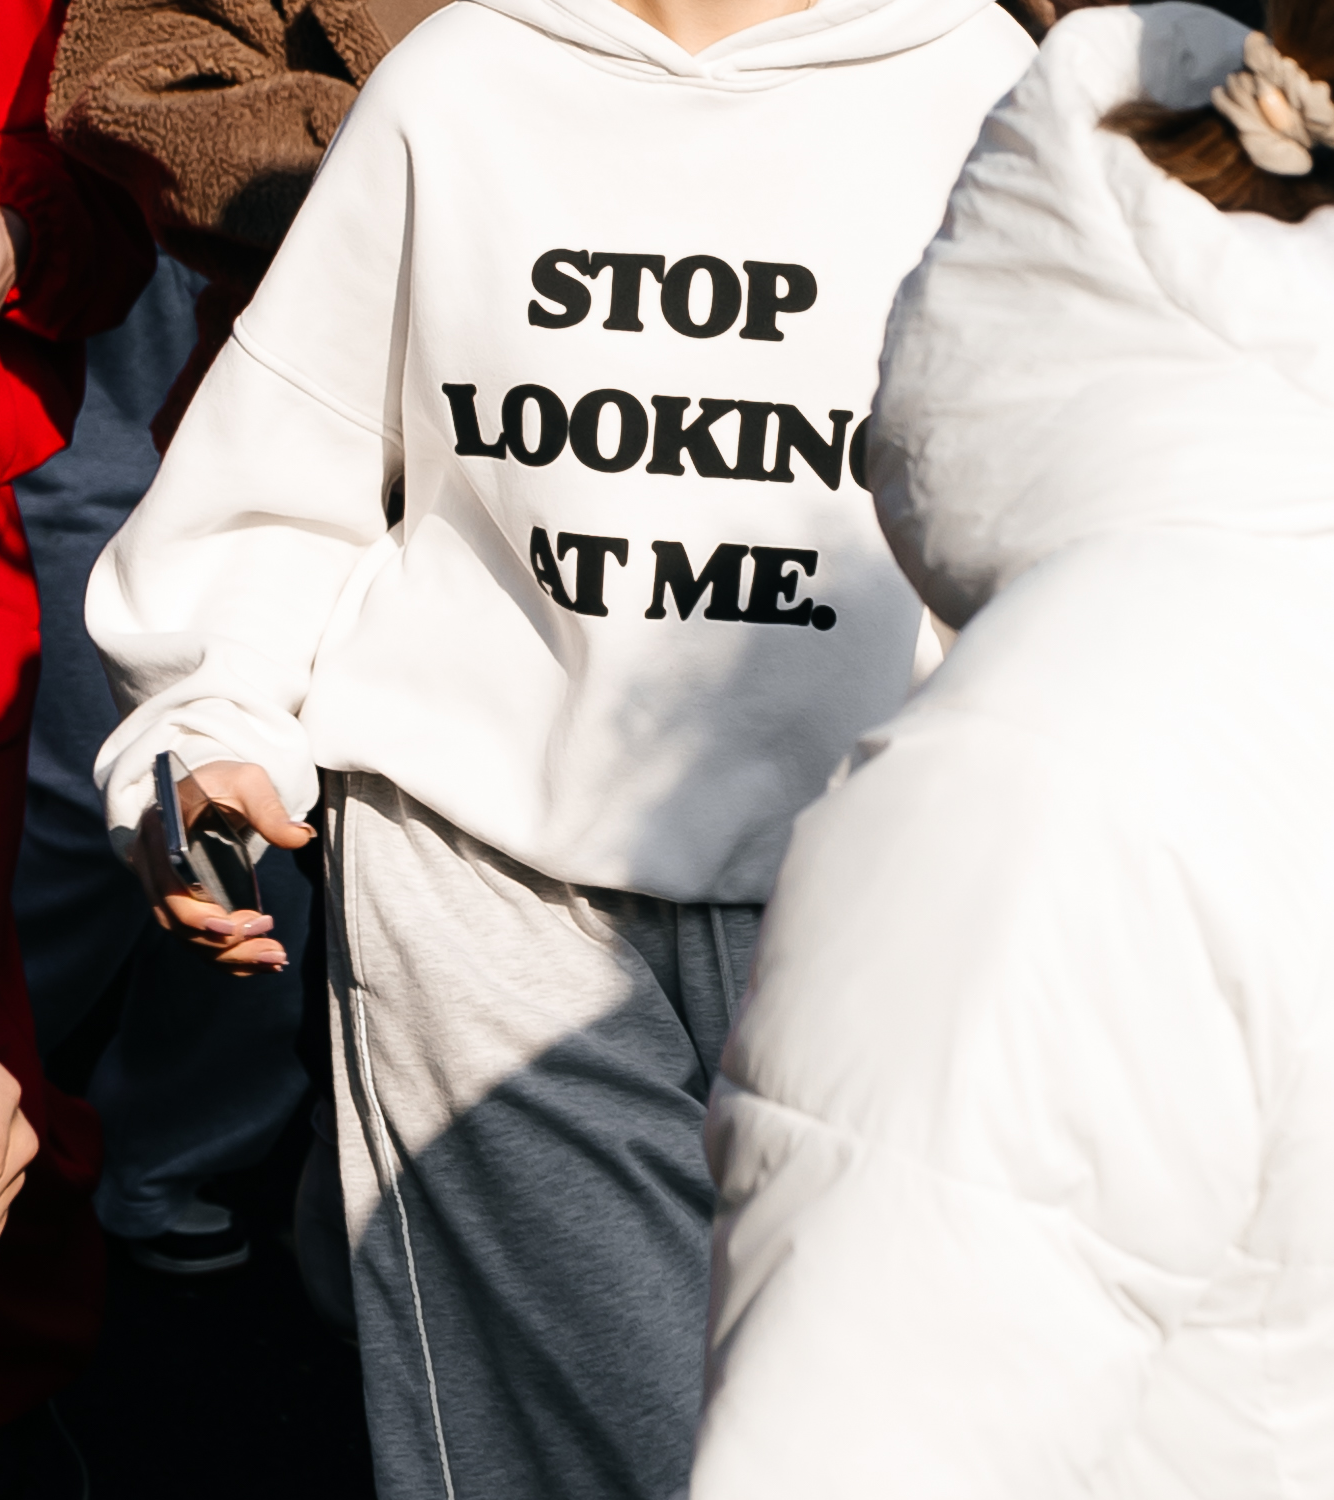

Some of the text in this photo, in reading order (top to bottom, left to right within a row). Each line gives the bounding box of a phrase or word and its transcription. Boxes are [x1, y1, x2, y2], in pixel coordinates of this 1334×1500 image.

[527, 249, 818, 342] STOP
[530, 526, 837, 631] AT ME.
